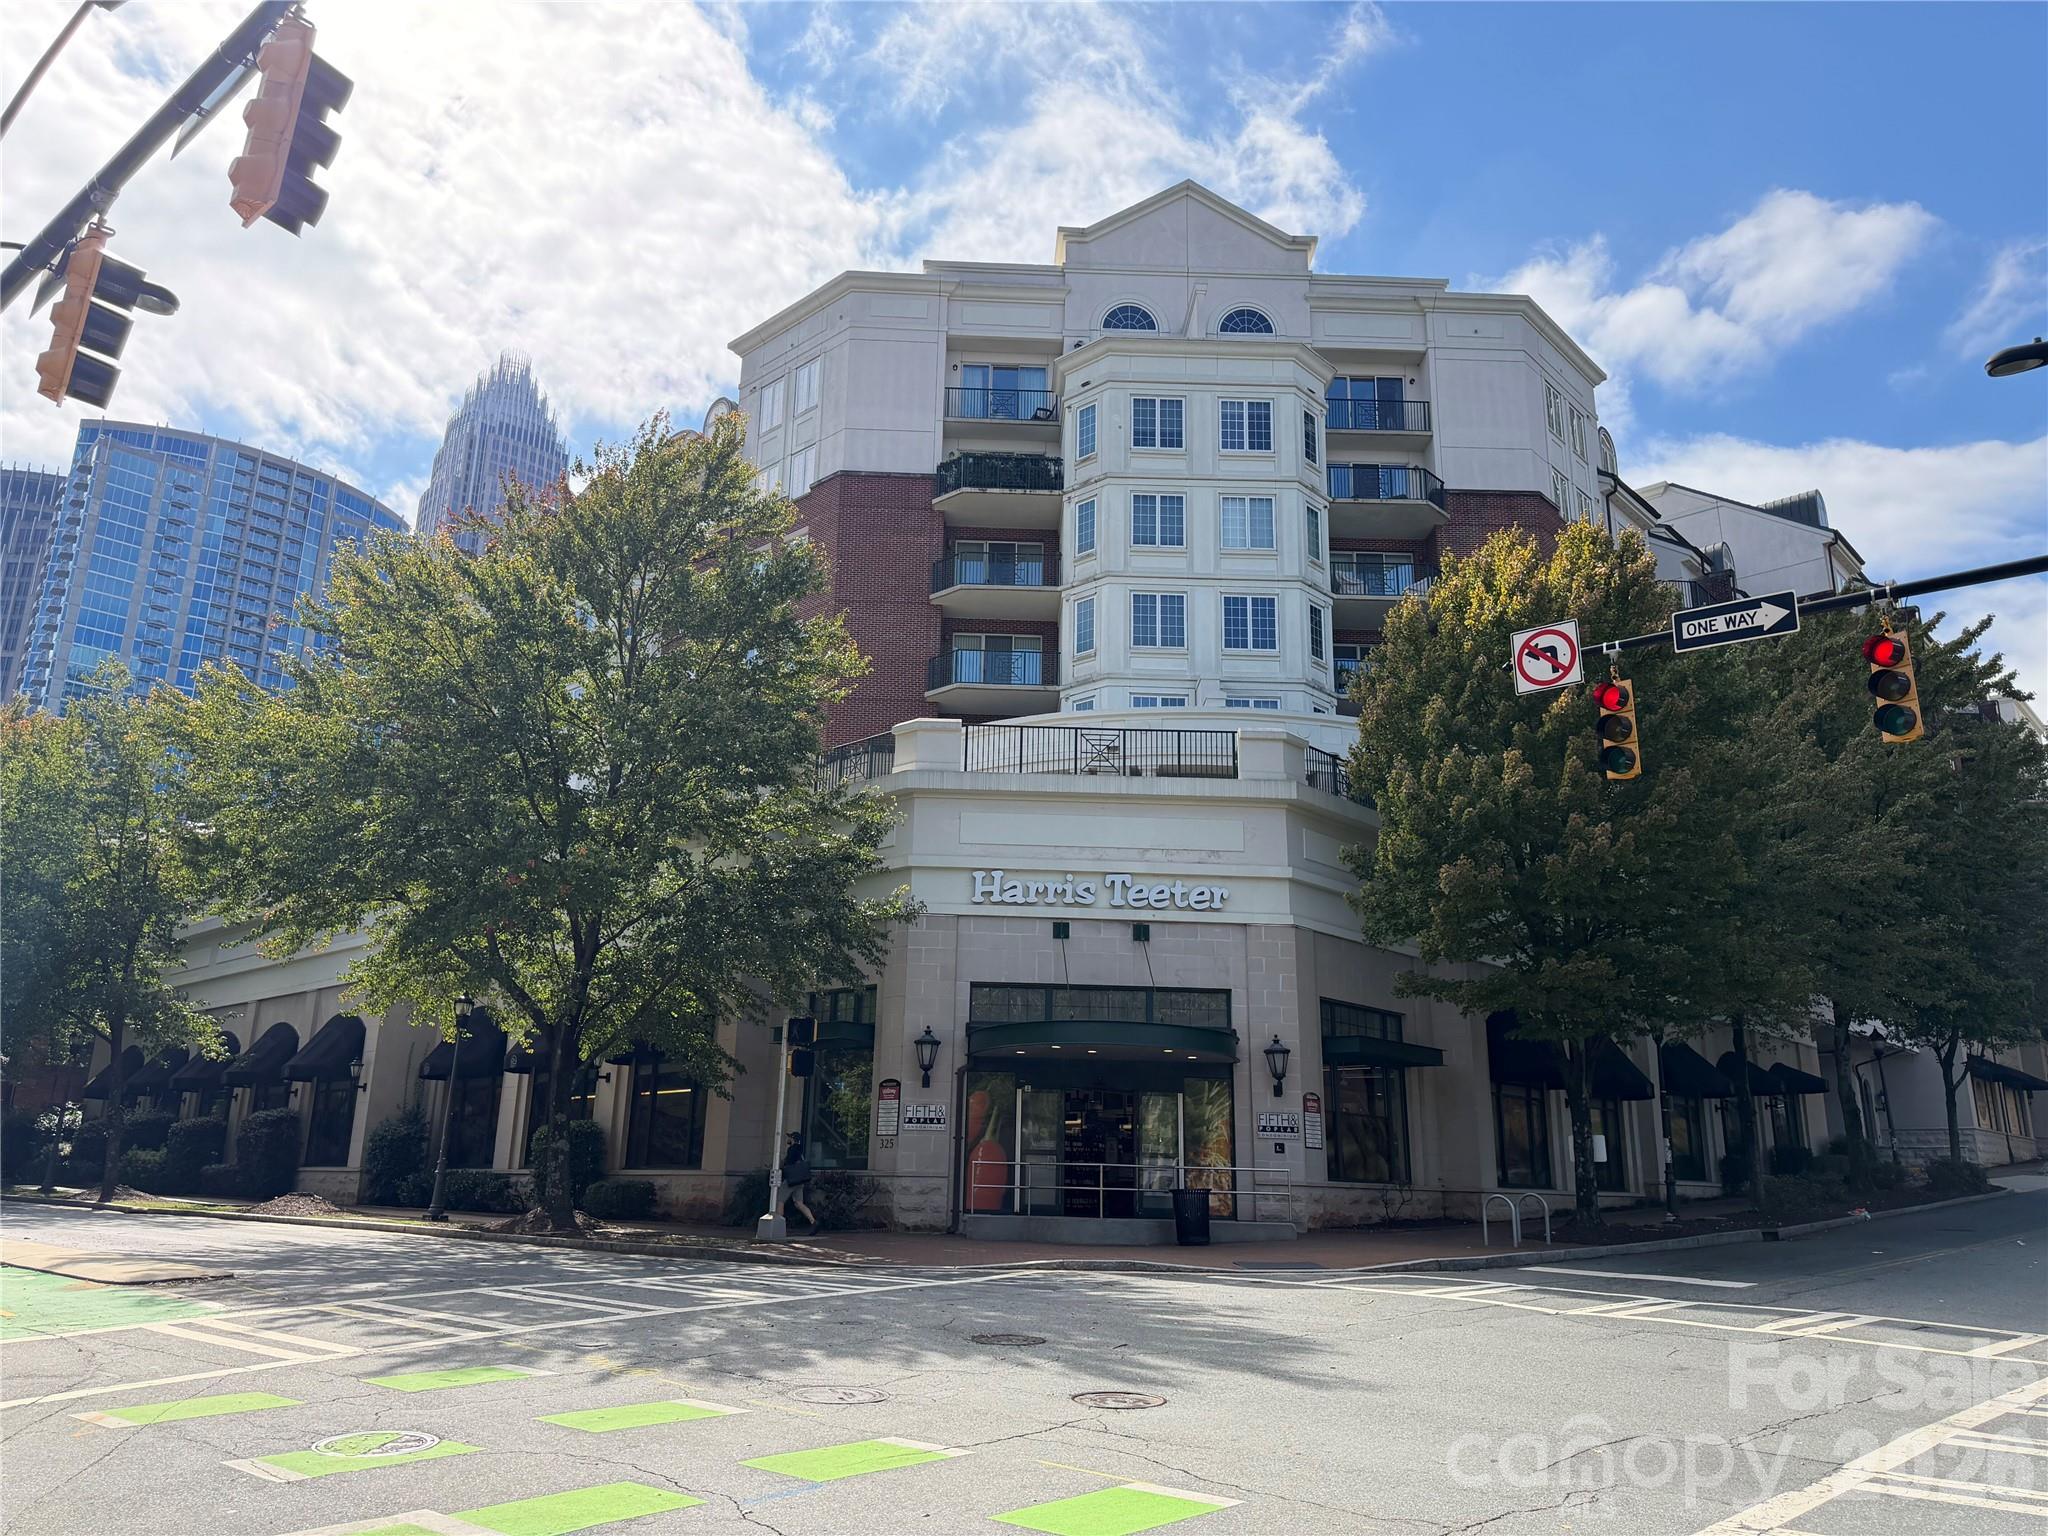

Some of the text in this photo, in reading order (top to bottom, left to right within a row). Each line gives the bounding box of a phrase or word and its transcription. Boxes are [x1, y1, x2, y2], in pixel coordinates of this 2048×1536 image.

[1687, 610, 1757, 636] ONE WAY
[971, 870, 1230, 911] Harris Teeter
[879, 1138, 895, 1149] 325
